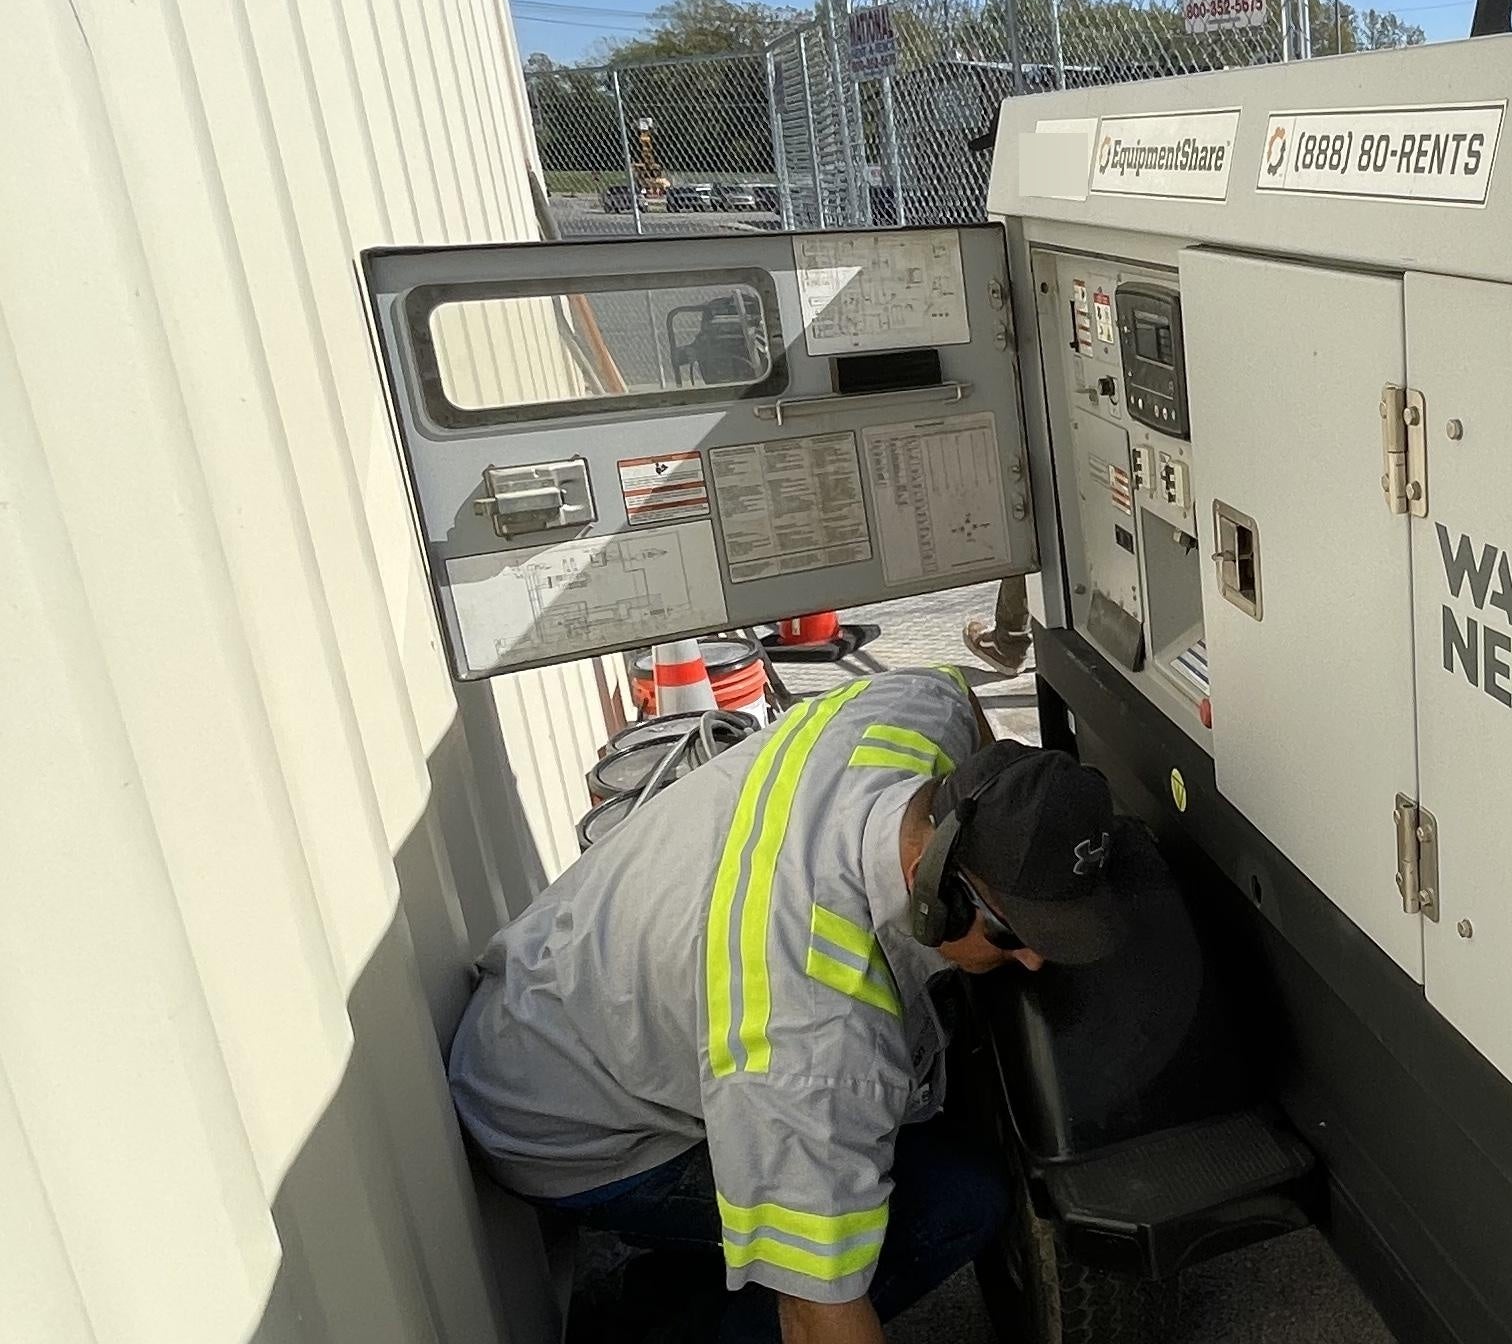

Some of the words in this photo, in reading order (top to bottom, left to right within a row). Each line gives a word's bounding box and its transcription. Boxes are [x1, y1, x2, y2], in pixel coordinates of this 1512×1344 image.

[1110, 138, 1225, 177] EquipmentShare
[1294, 131, 1353, 175] (888)
[1357, 133, 1485, 176] 80-RENTS
